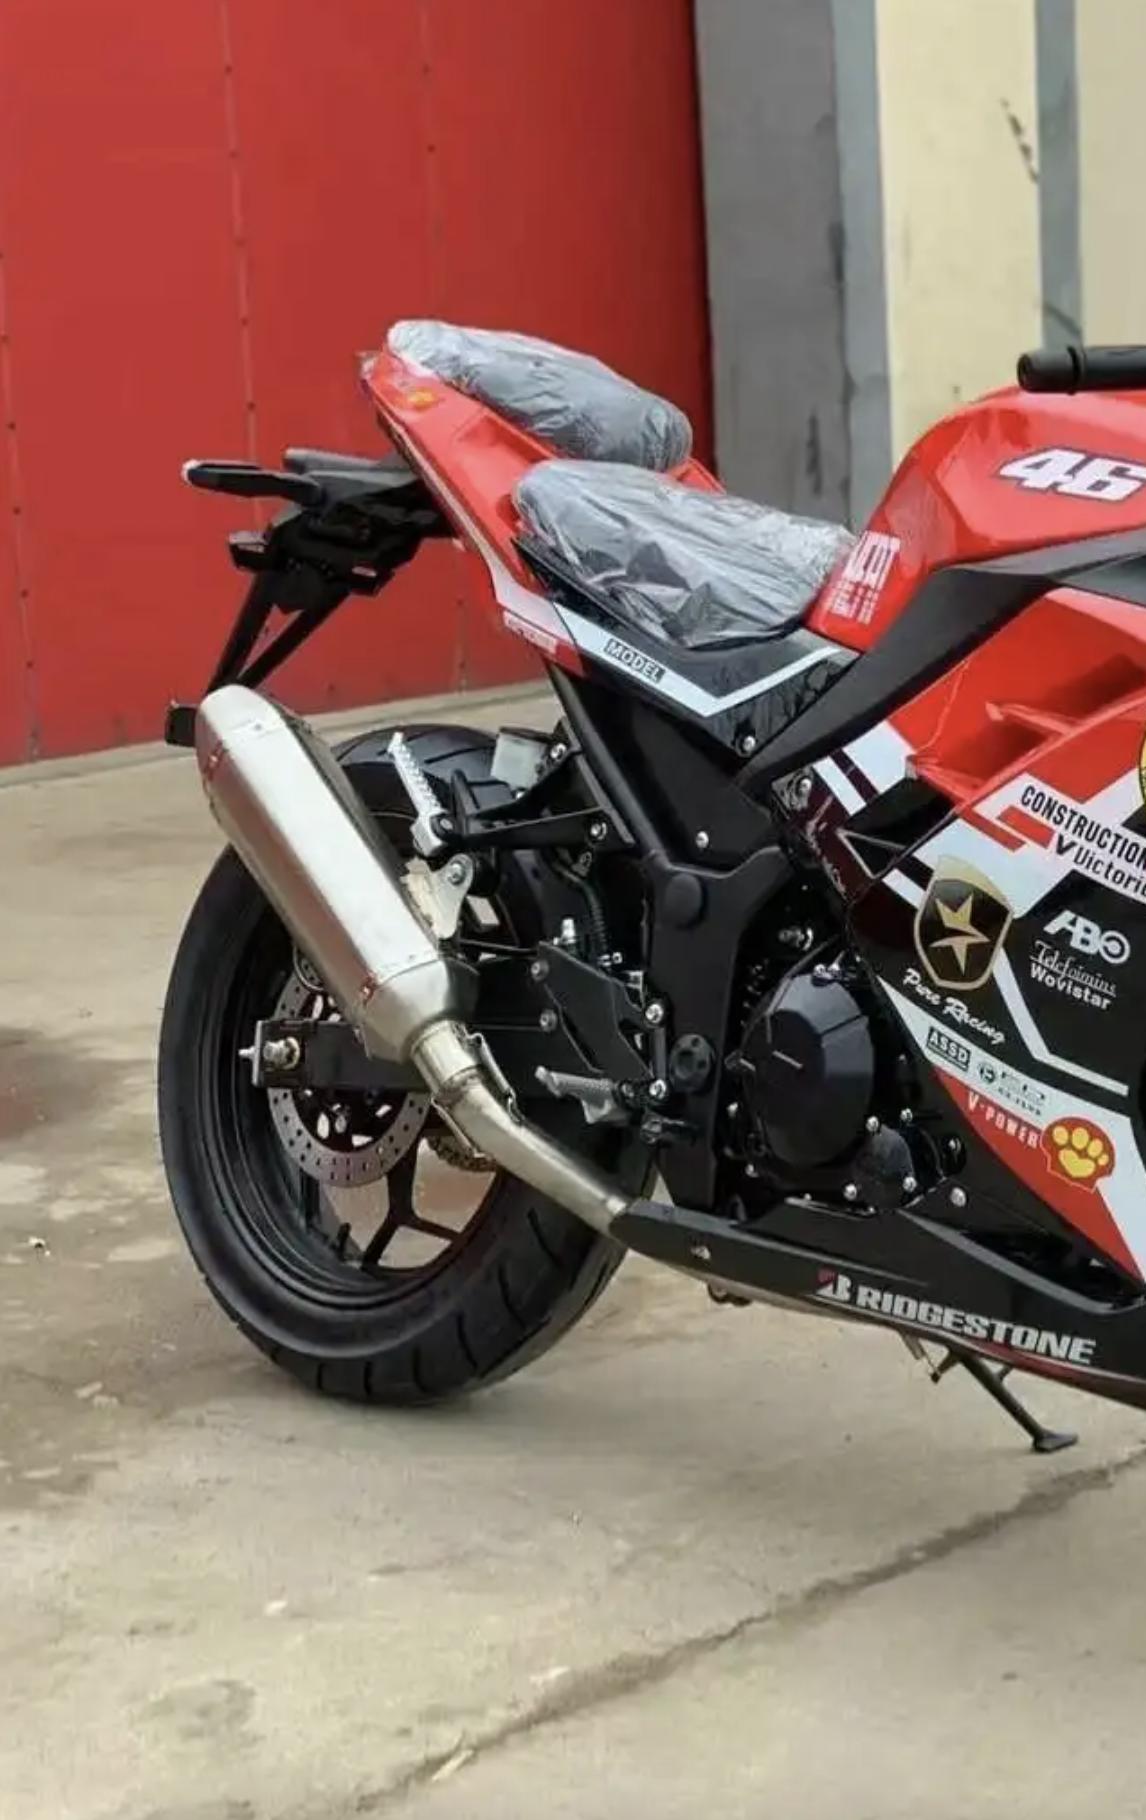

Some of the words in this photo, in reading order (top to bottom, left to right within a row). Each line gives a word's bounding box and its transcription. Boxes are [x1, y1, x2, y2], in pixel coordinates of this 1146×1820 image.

[607, 640, 662, 683] MODEL
[943, 997, 1006, 1045] Racing
[929, 1029, 970, 1064] ASSD
[968, 1091, 1041, 1149] V-POWER
